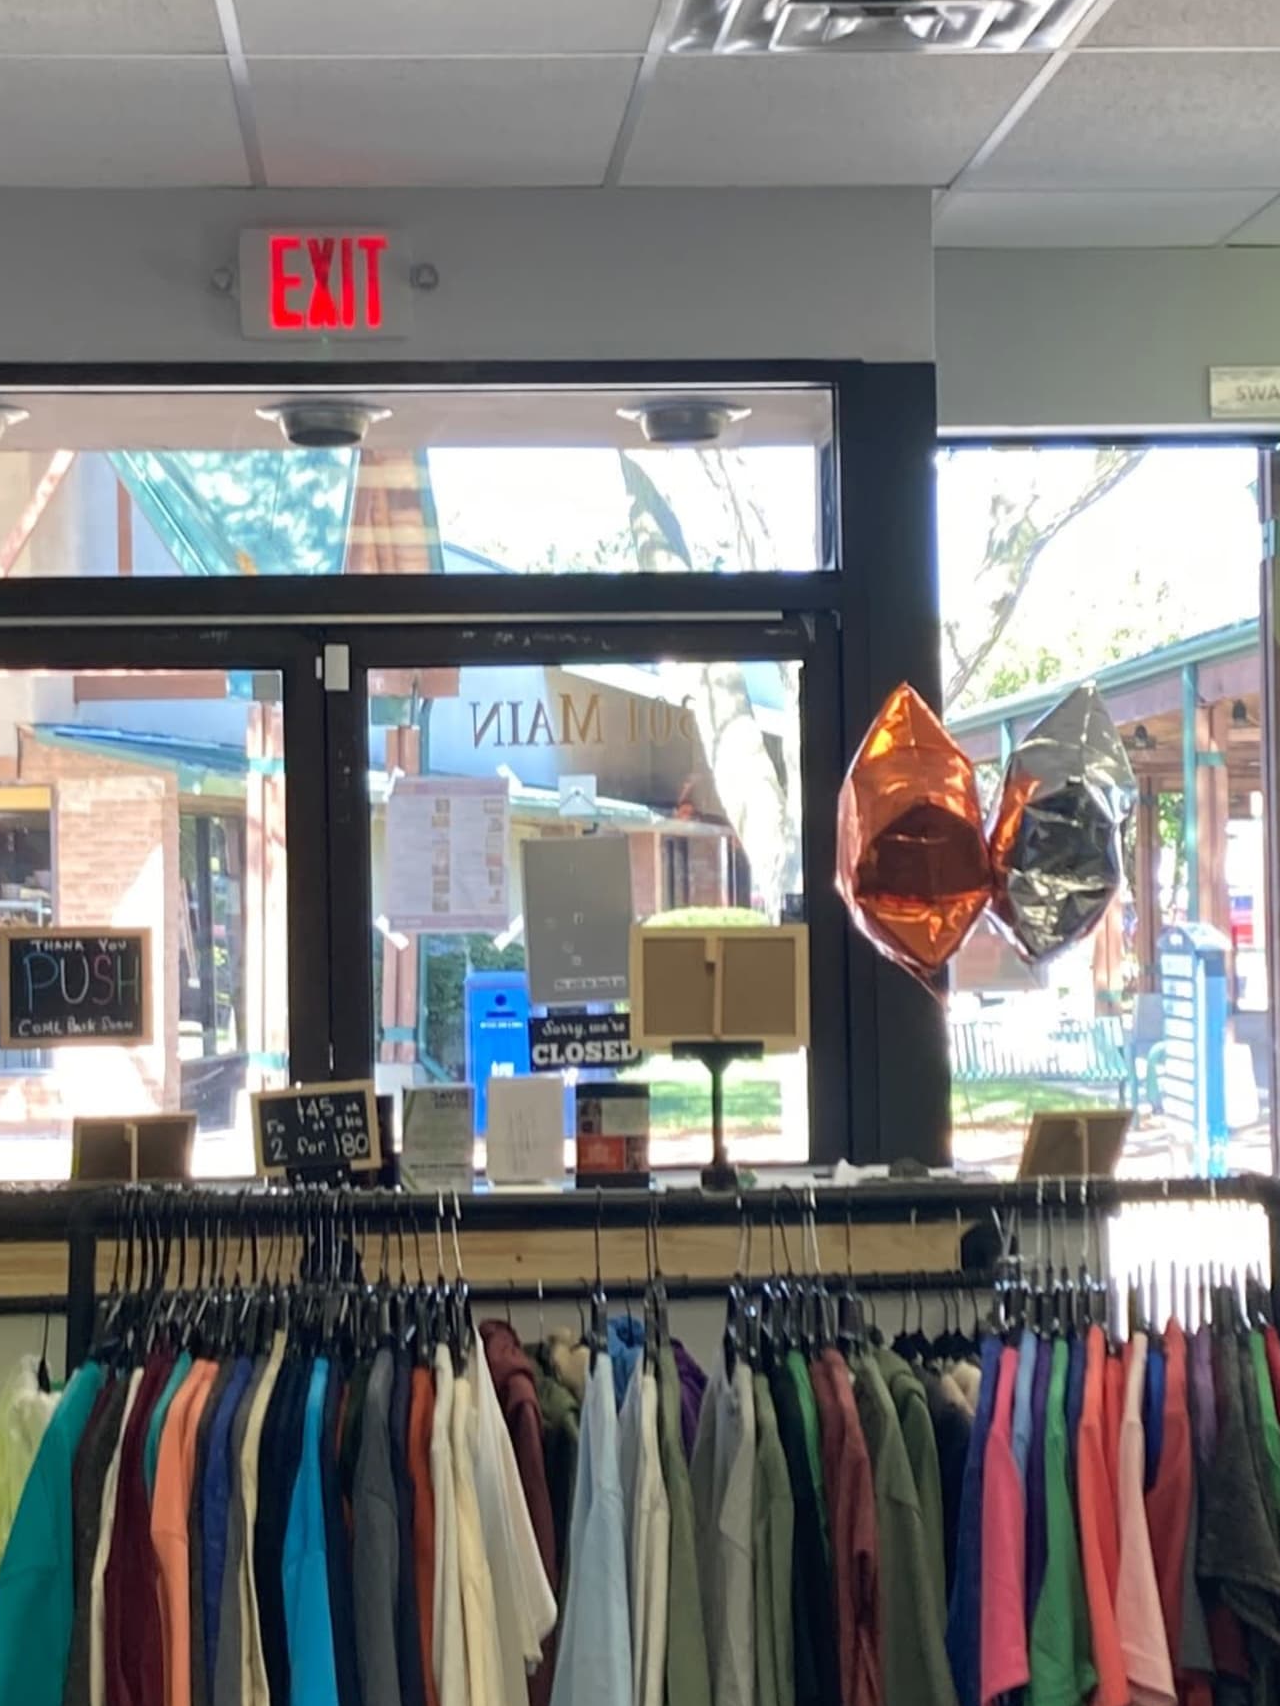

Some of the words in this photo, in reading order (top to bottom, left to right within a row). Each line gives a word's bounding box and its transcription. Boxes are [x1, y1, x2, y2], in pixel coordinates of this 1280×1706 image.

[270, 235, 388, 330] EXIT
[30, 940, 84, 951] THANK
[23, 952, 139, 1013] PUSH
[532, 1041, 639, 1065] CLOSED
